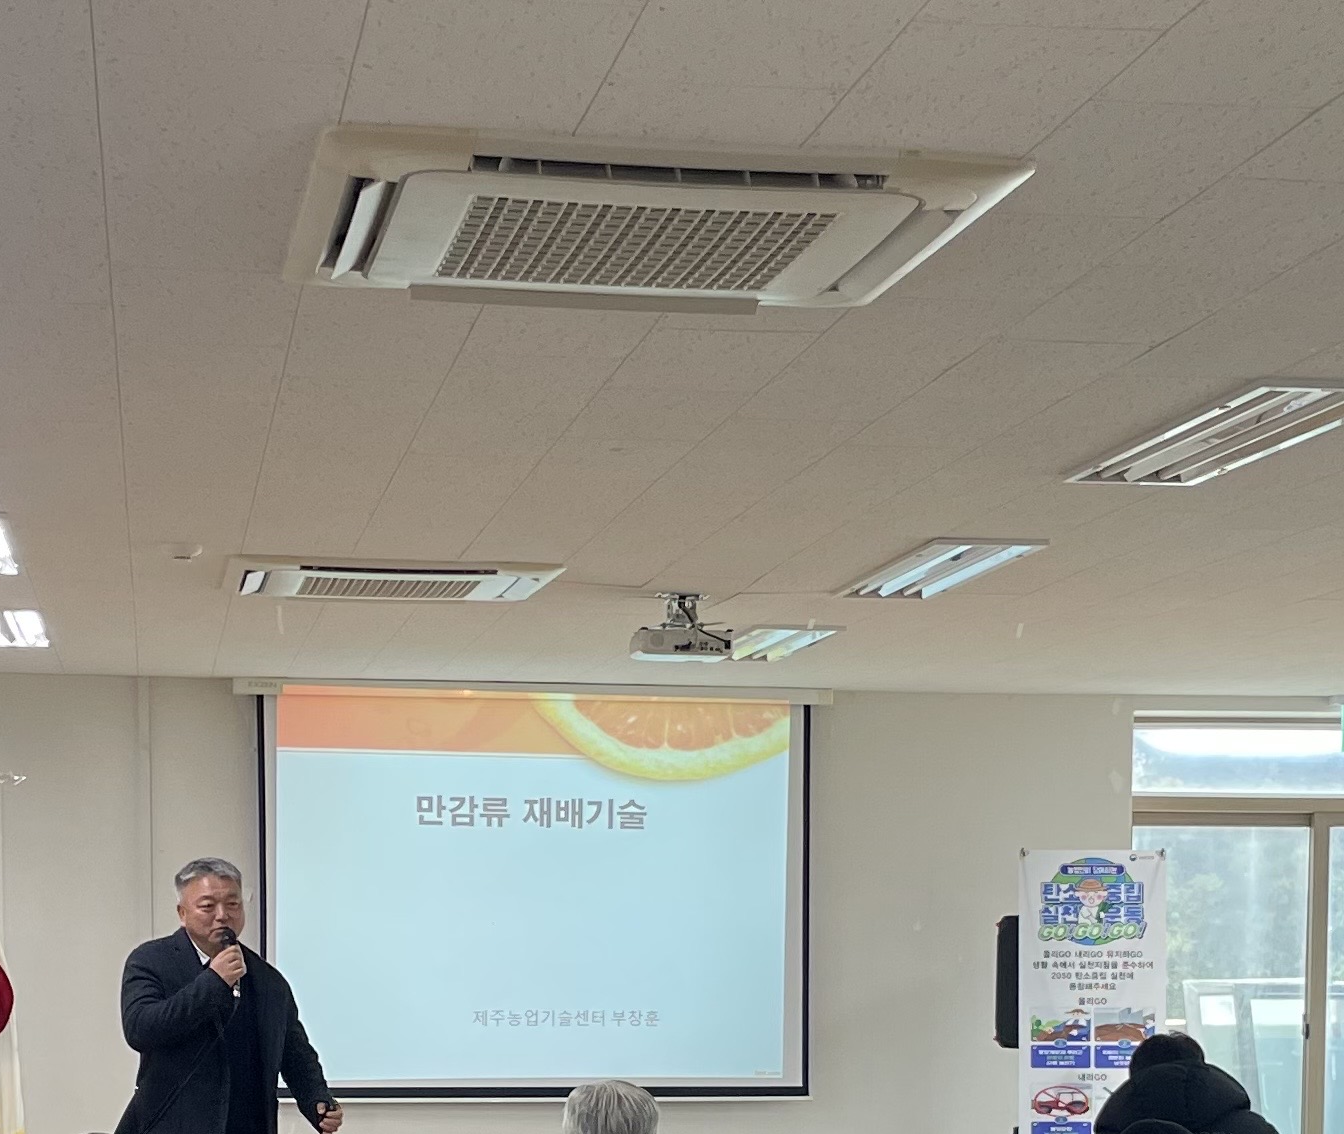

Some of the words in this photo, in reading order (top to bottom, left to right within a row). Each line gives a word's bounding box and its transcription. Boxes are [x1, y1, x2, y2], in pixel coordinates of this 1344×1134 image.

[416, 795, 511, 828] 만감류
[522, 797, 648, 830] 재배기술
[1042, 883, 1080, 902] 탄소
[472, 1009, 606, 1027] 제주농업기술센터
[610, 1010, 660, 1027] 부창훈
